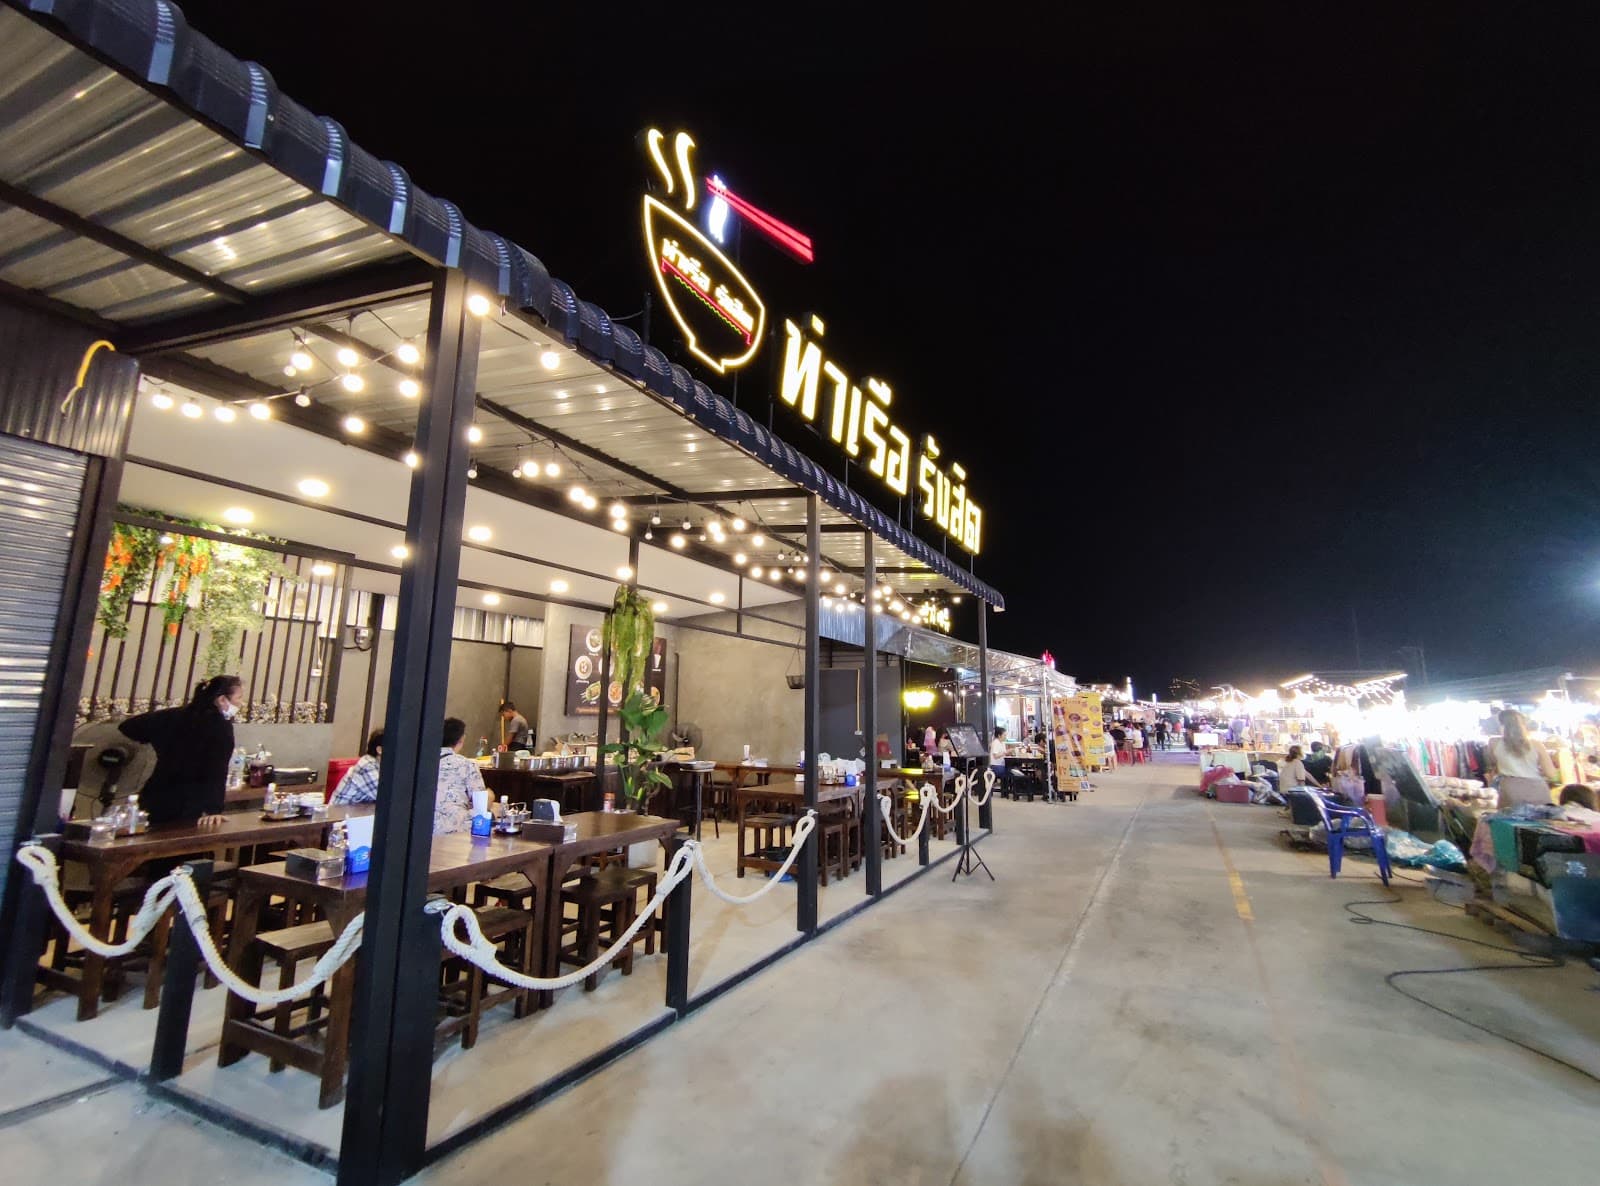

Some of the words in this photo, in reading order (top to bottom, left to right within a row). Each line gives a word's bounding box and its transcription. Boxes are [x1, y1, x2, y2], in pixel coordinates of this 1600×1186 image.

[780, 313, 911, 497] ท่าเรือ
[918, 435, 983, 556] รังสิต
